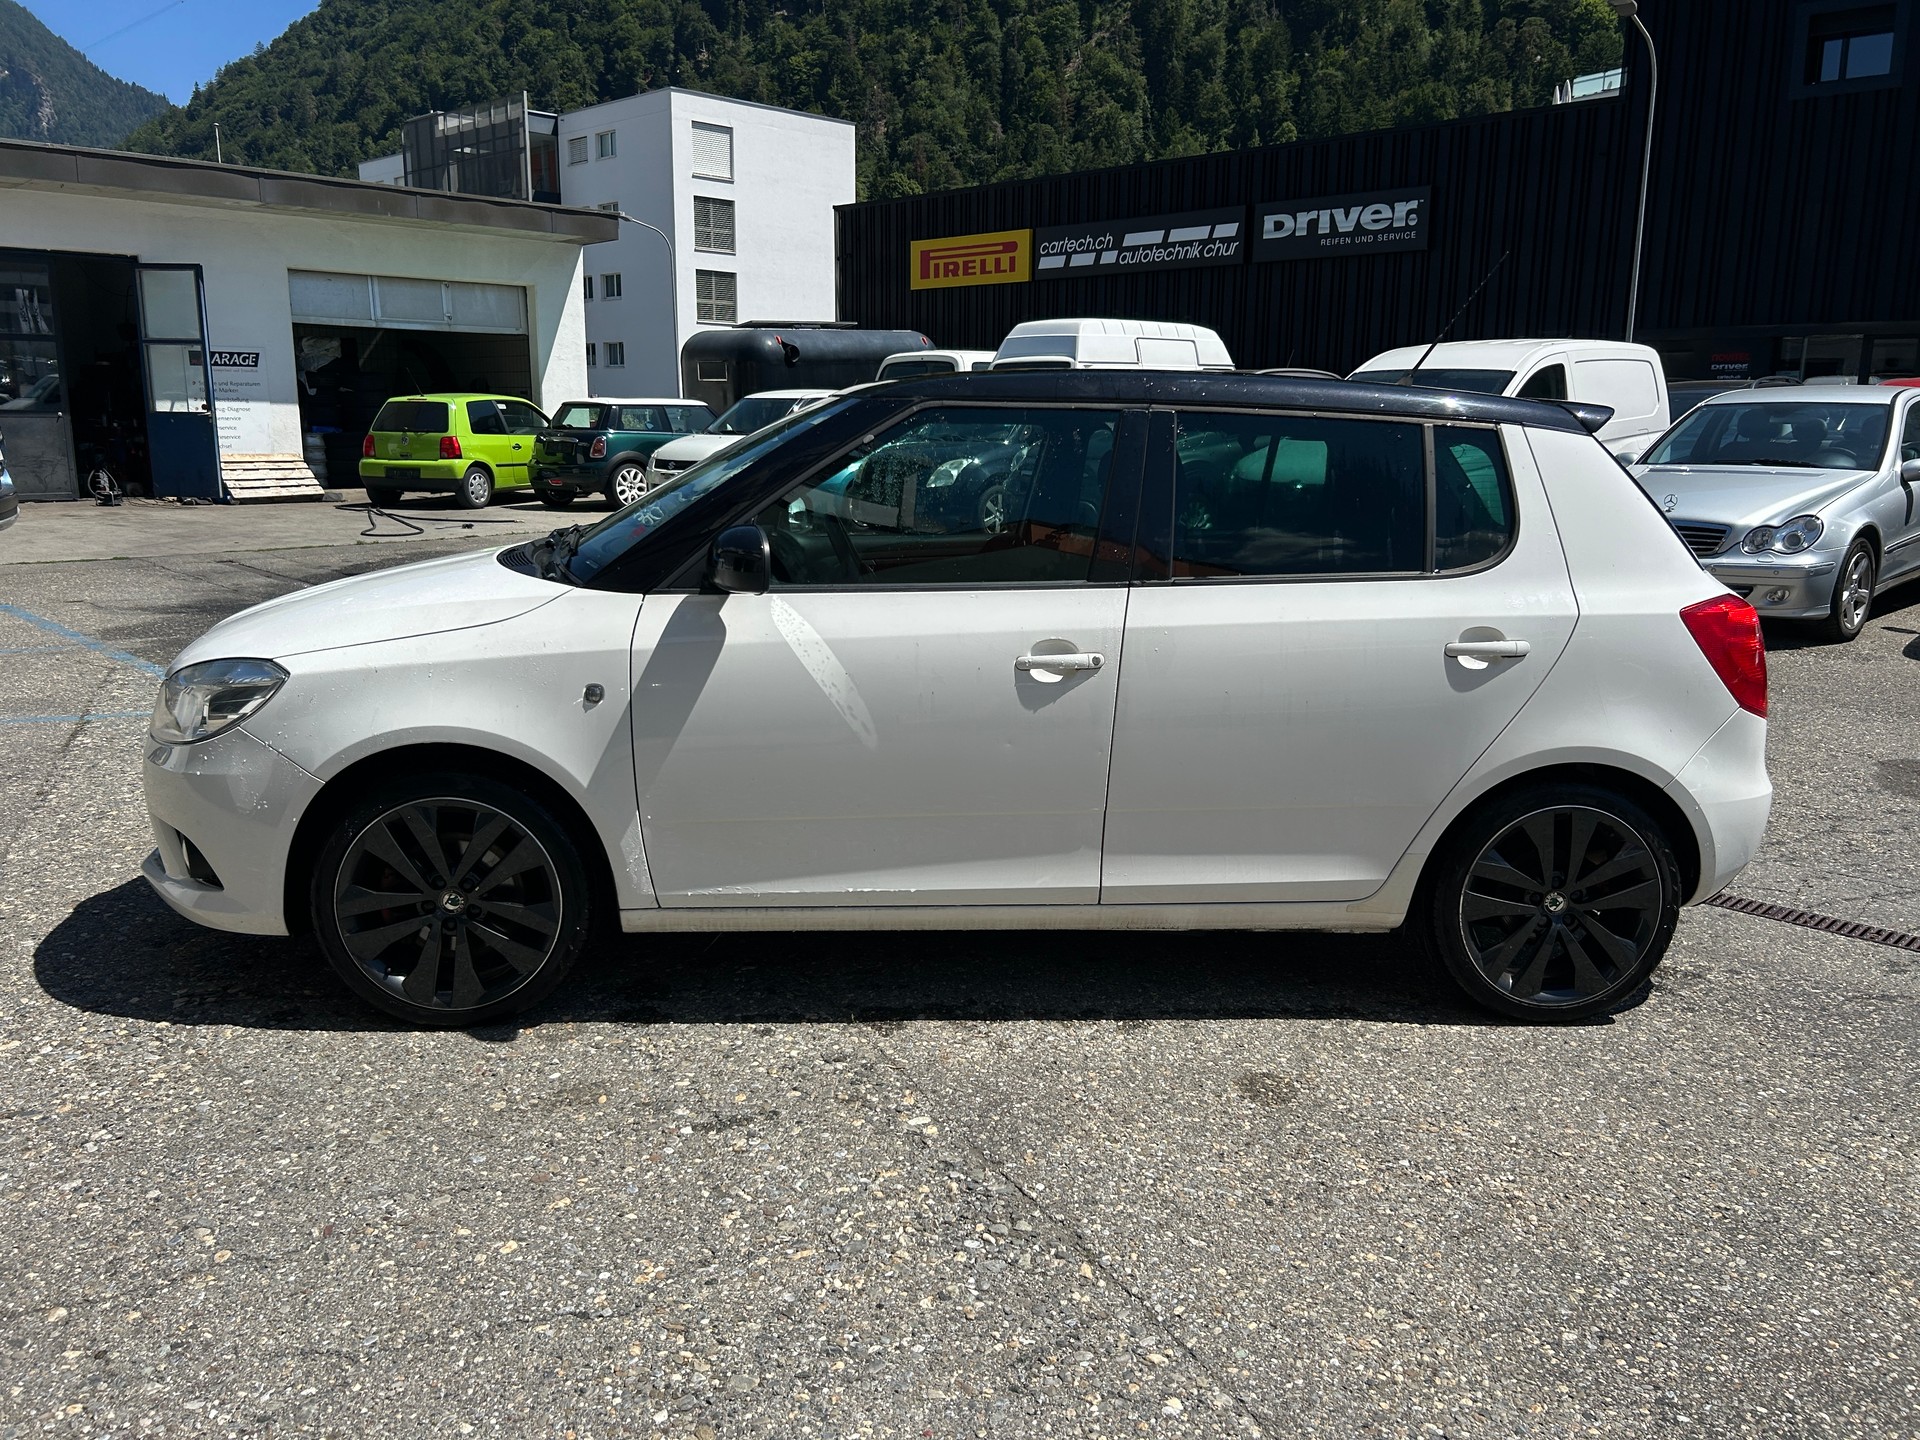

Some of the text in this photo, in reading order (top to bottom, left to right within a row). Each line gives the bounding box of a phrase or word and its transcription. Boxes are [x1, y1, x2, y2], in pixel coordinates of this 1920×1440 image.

[1039, 232, 1114, 255] cartech.ch
[1320, 230, 1417, 247] REIFEN UND SERVICE
[919, 240, 1019, 281] PIRELLI
[1118, 240, 1240, 265] autotechnik chur
[211, 353, 256, 366] ARAGE
